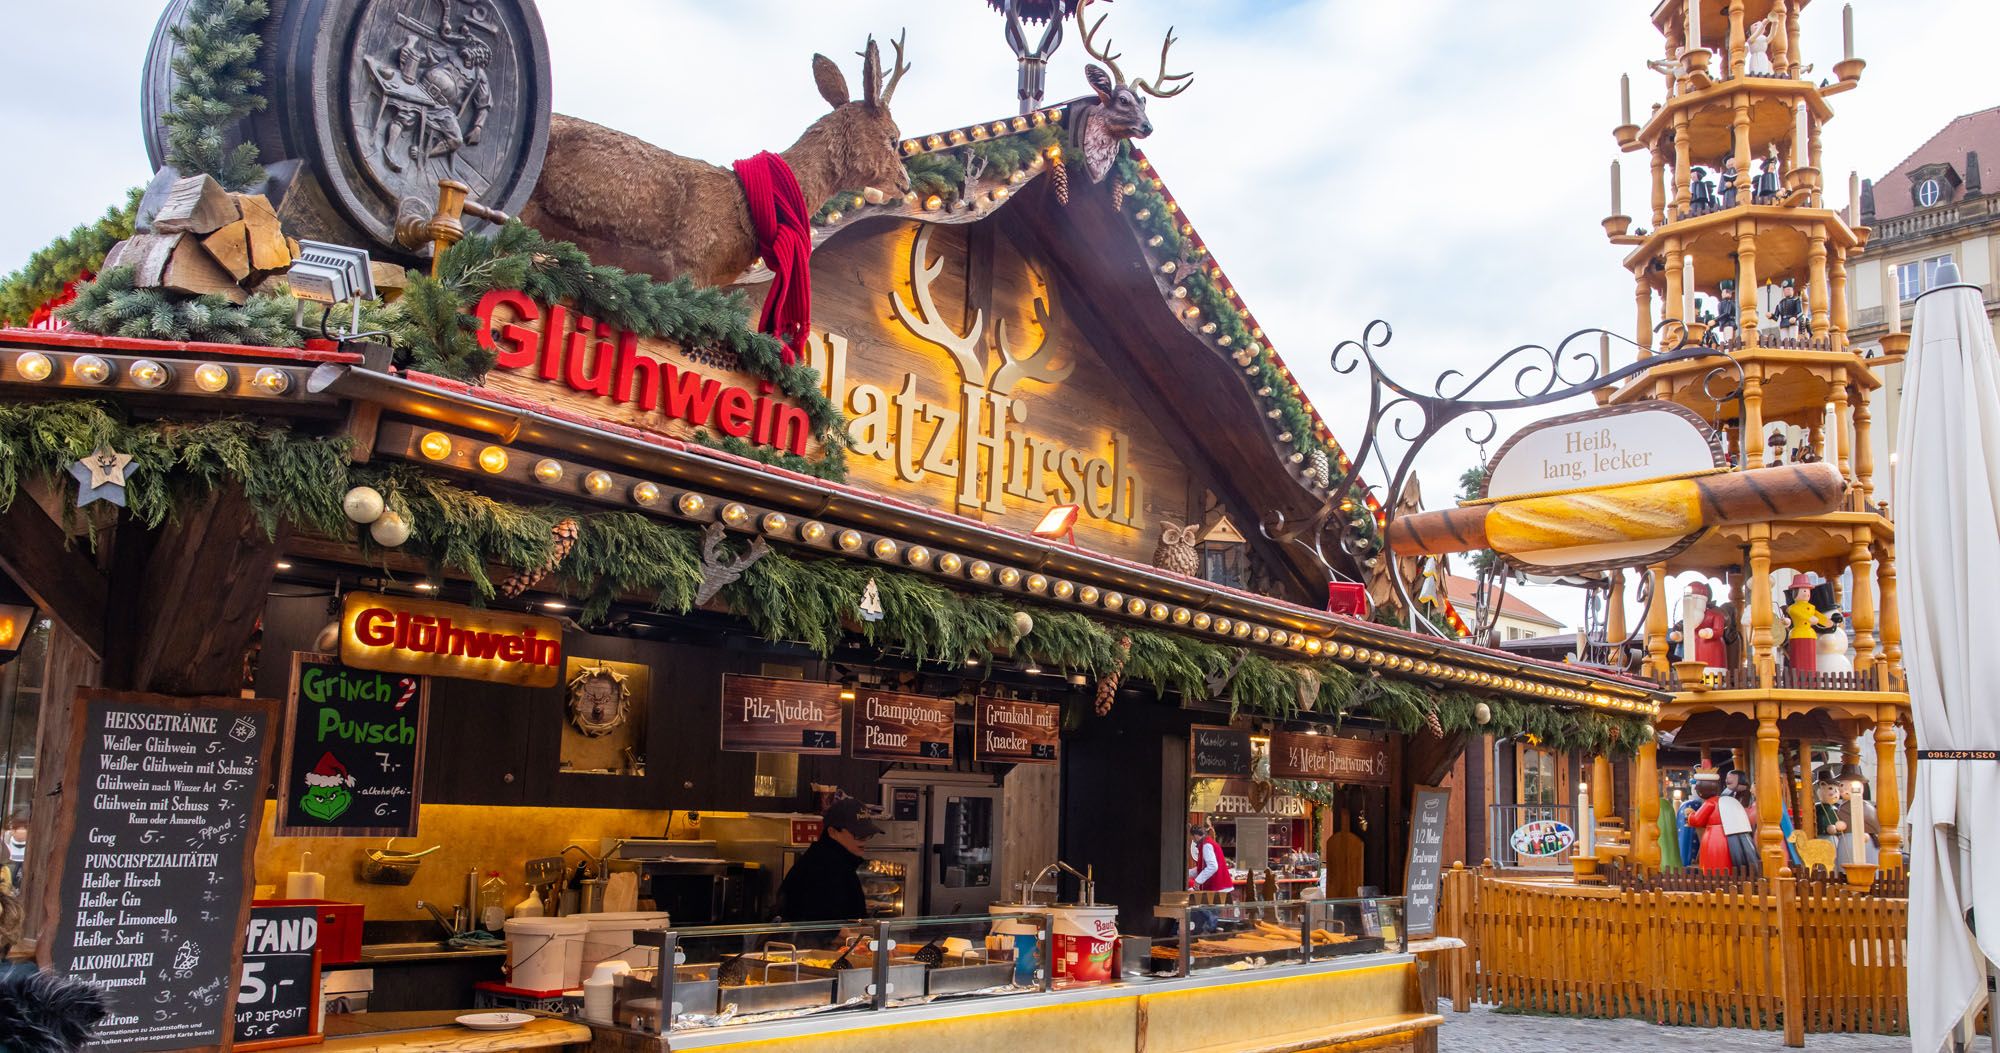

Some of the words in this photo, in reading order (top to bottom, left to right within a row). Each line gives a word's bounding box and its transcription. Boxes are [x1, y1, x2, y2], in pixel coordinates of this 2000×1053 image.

[475, 289, 810, 457] Glühwein
[1566, 428, 1617, 454] Heiß,
[1544, 459, 1587, 481] lang,
[1594, 449, 1652, 472] lecker
[354, 607, 561, 666] Glühwein
[743, 697, 823, 724] Pilz-Nudeln
[866, 697, 946, 725] Champignon-
[986, 704, 1033, 726] Grünkohl
[1036, 710, 1054, 729] mit
[104, 711, 218, 734] HEISSGETRÄNKE
[103, 734, 142, 752] Weißer
[145, 736, 197, 754] Glühwein
[864, 725, 908, 749] Pfanne
[986, 730, 1028, 752] Knacker
[100, 754, 139, 771] Weißer
[142, 756, 194, 774] Glühwein
[196, 761, 214, 774] mit
[217, 760, 254, 776] Schuss
[1300, 747, 1326, 772] Meter
[1329, 750, 1374, 775] Bratwurst
[96, 774, 150, 791] Glühwein
[151, 780, 171, 792] nach
[174, 780, 201, 792] Winzer
[203, 782, 216, 793] Art
[94, 794, 146, 810] Glühwein
[149, 798, 168, 810] mit
[171, 796, 209, 811] Schuss
[128, 813, 148, 824] Rum
[150, 814, 168, 824] oder
[169, 814, 206, 825] Amaretto
[88, 828, 116, 847] Grog
[84, 851, 218, 869] PUNSCHSPEZIALITÄTEN
[82, 872, 121, 888] Heißer
[124, 872, 161, 888] Hirsch
[78, 892, 118, 908] Heißer
[121, 890, 141, 906] Gin
[76, 910, 115, 927] Heißer
[118, 909, 178, 926] Limoncello
[73, 930, 112, 947] Heißer
[115, 930, 144, 946] Sarti
[245, 917, 318, 953] FAND
[70, 952, 154, 972] ALKOHOLFREI
[234, 1012, 254, 1023] UP
[255, 1007, 307, 1022] DEPOSIT
[102, 1038, 122, 1046] halten
[149, 1034, 176, 1042] separate
[194, 1029, 216, 1037] bereit!
[266, 1023, 280, 1035] €
